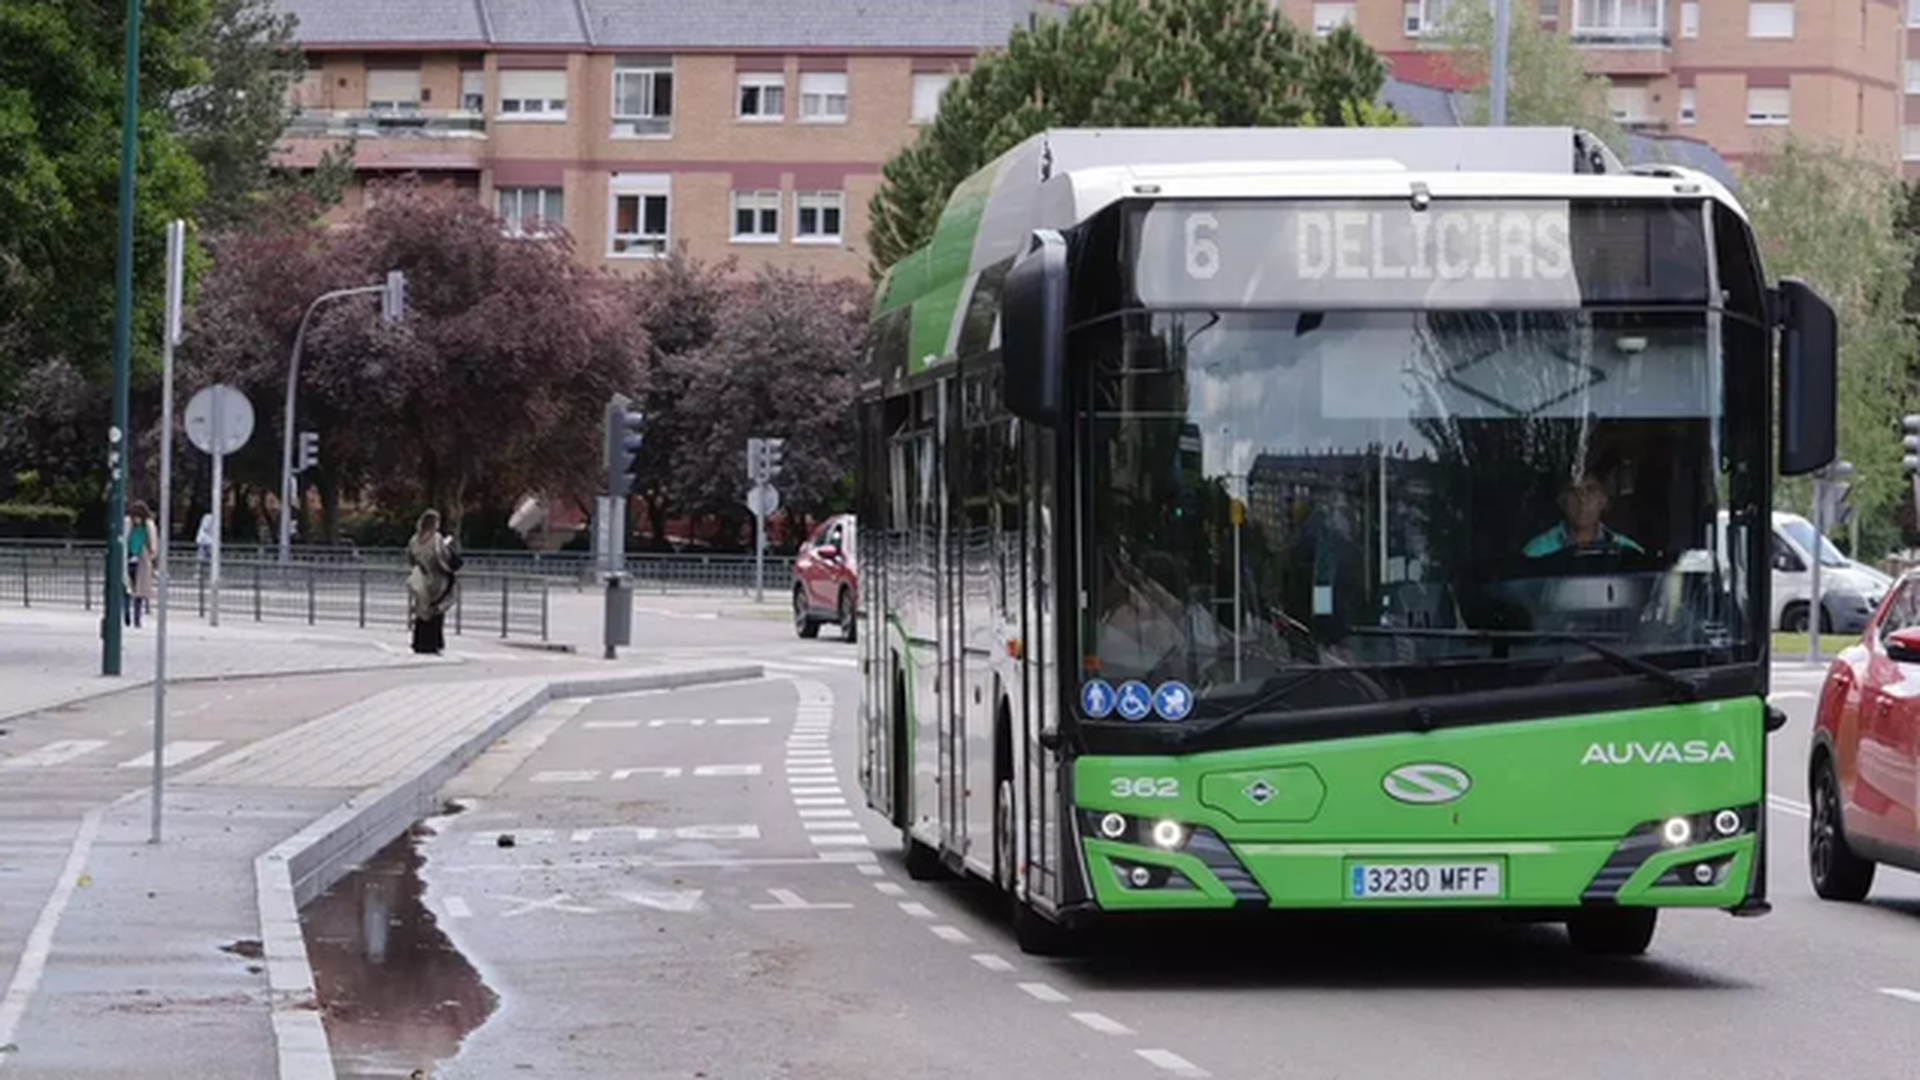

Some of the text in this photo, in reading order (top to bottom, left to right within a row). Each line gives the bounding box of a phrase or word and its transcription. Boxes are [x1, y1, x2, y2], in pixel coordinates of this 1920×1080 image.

[1184, 210, 1571, 280] 6 DELICIAS
[1581, 740, 1735, 765] AUVASA
[1110, 777, 1179, 798] 362
[1368, 867, 1430, 892] 3230
[1440, 867, 1488, 891] MFF
